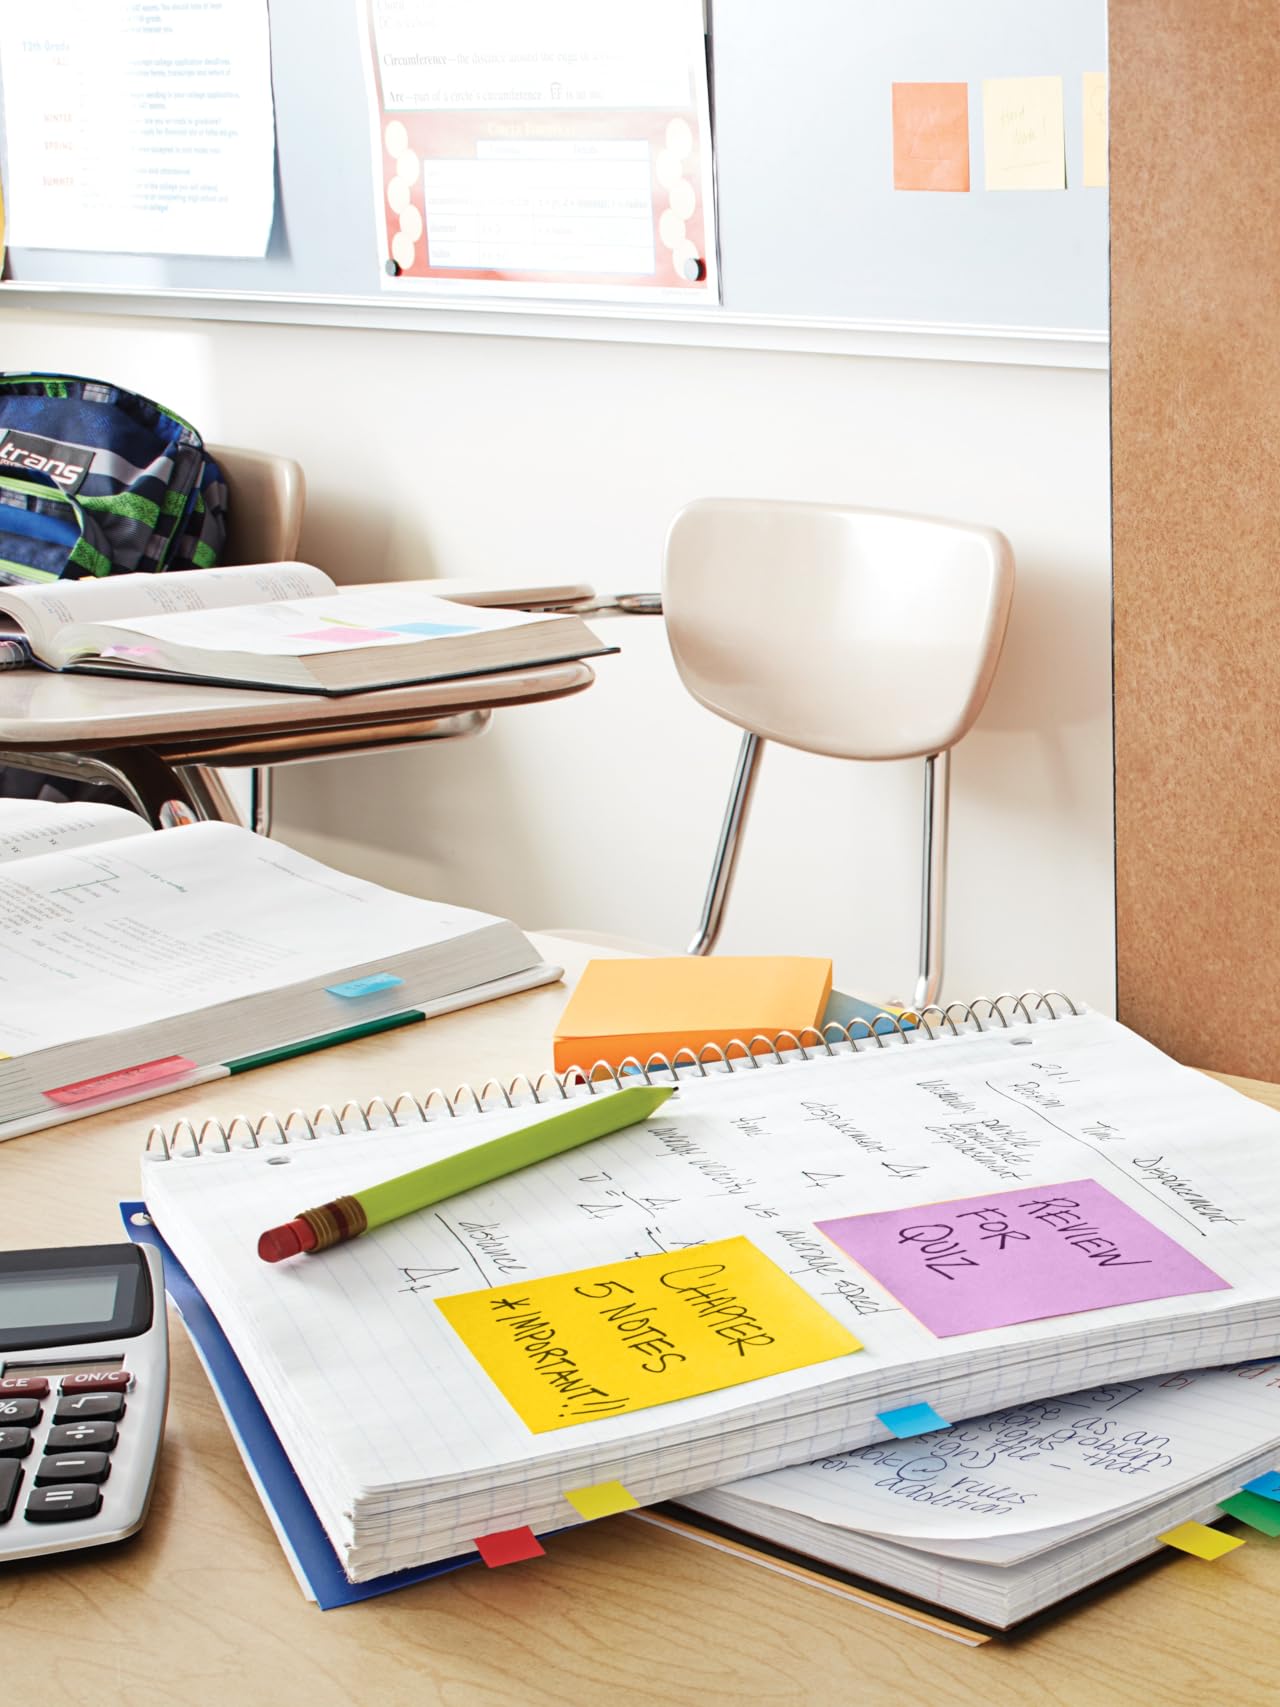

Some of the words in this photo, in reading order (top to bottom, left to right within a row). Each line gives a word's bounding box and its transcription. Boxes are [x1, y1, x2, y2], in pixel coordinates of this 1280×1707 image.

[0, 442, 84, 485] trans
[1132, 1156, 1246, 1225] Displacement
[458, 1220, 528, 1274] distance
[955, 1207, 1031, 1250] FOR
[1018, 1196, 1153, 1268] REVIEW
[776, 1230, 844, 1275] average
[820, 1279, 902, 1316] speed
[899, 1223, 980, 1280] QUIZ
[573, 1281, 634, 1299] 5
[659, 1264, 776, 1357] CHAPTER
[599, 1302, 687, 1373] NOTES
[2, 1378, 31, 1388] CE
[74, 1371, 121, 1383] ON/C
[985, 1442, 1041, 1461] the
[1051, 1429, 1173, 1468] problem
[1072, 1417, 1117, 1435] as
[1122, 1431, 1171, 1449] an
[1083, 1453, 1151, 1475] that
[874, 1477, 1013, 1515] addition
[952, 1476, 1038, 1505] rules
